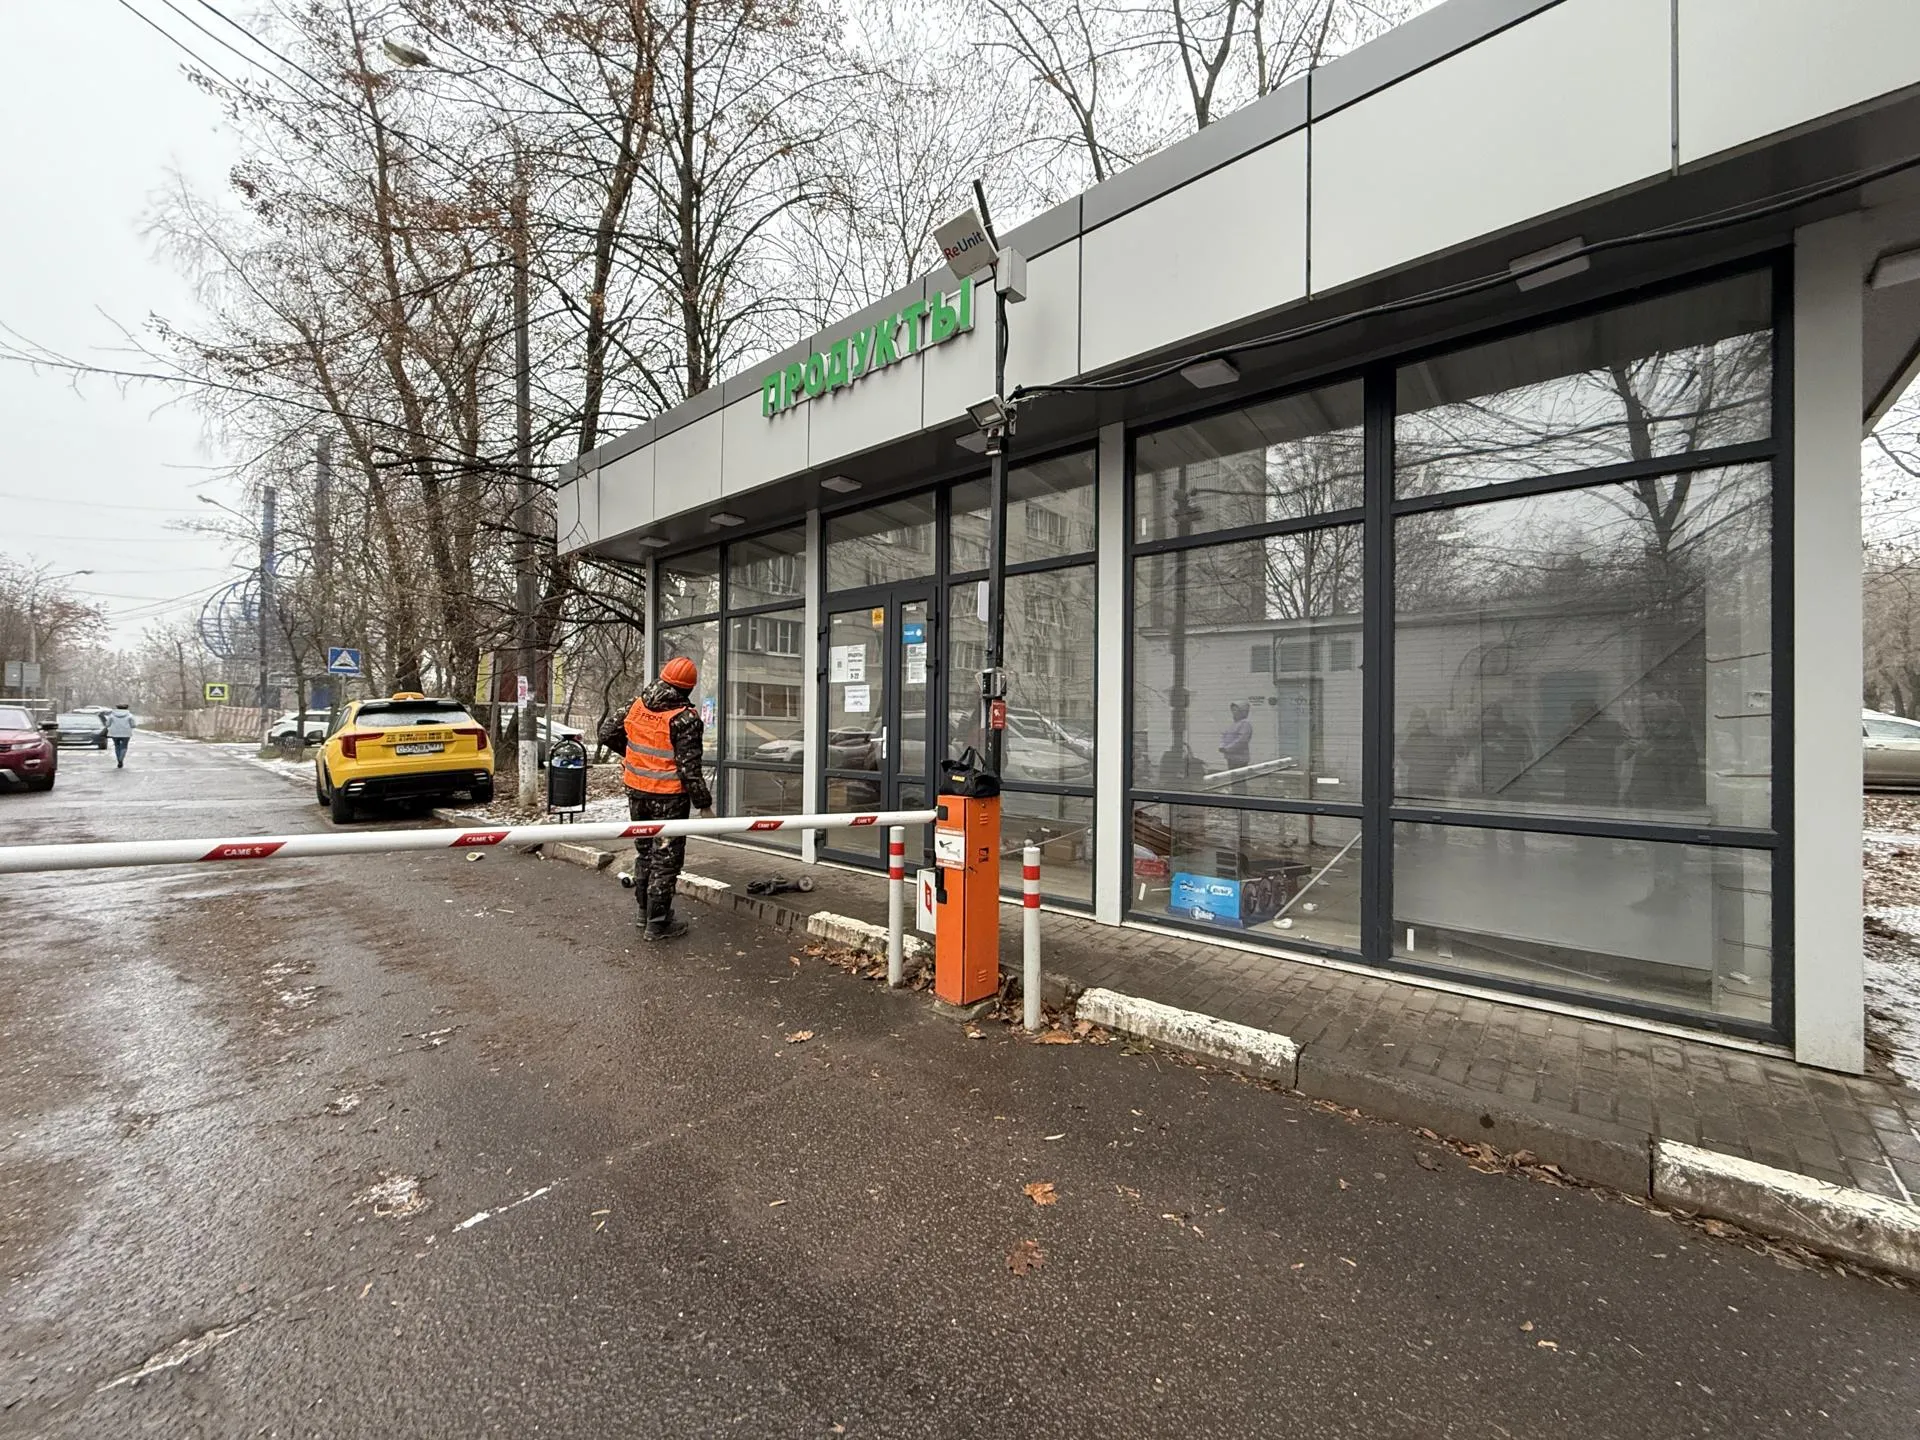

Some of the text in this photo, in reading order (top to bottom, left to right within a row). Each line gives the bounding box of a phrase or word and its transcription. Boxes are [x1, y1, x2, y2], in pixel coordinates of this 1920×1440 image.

[943, 231, 985, 261] ReUnit
[762, 276, 976, 418] ПРОДУКТЫ
[223, 847, 252, 856] CAME
